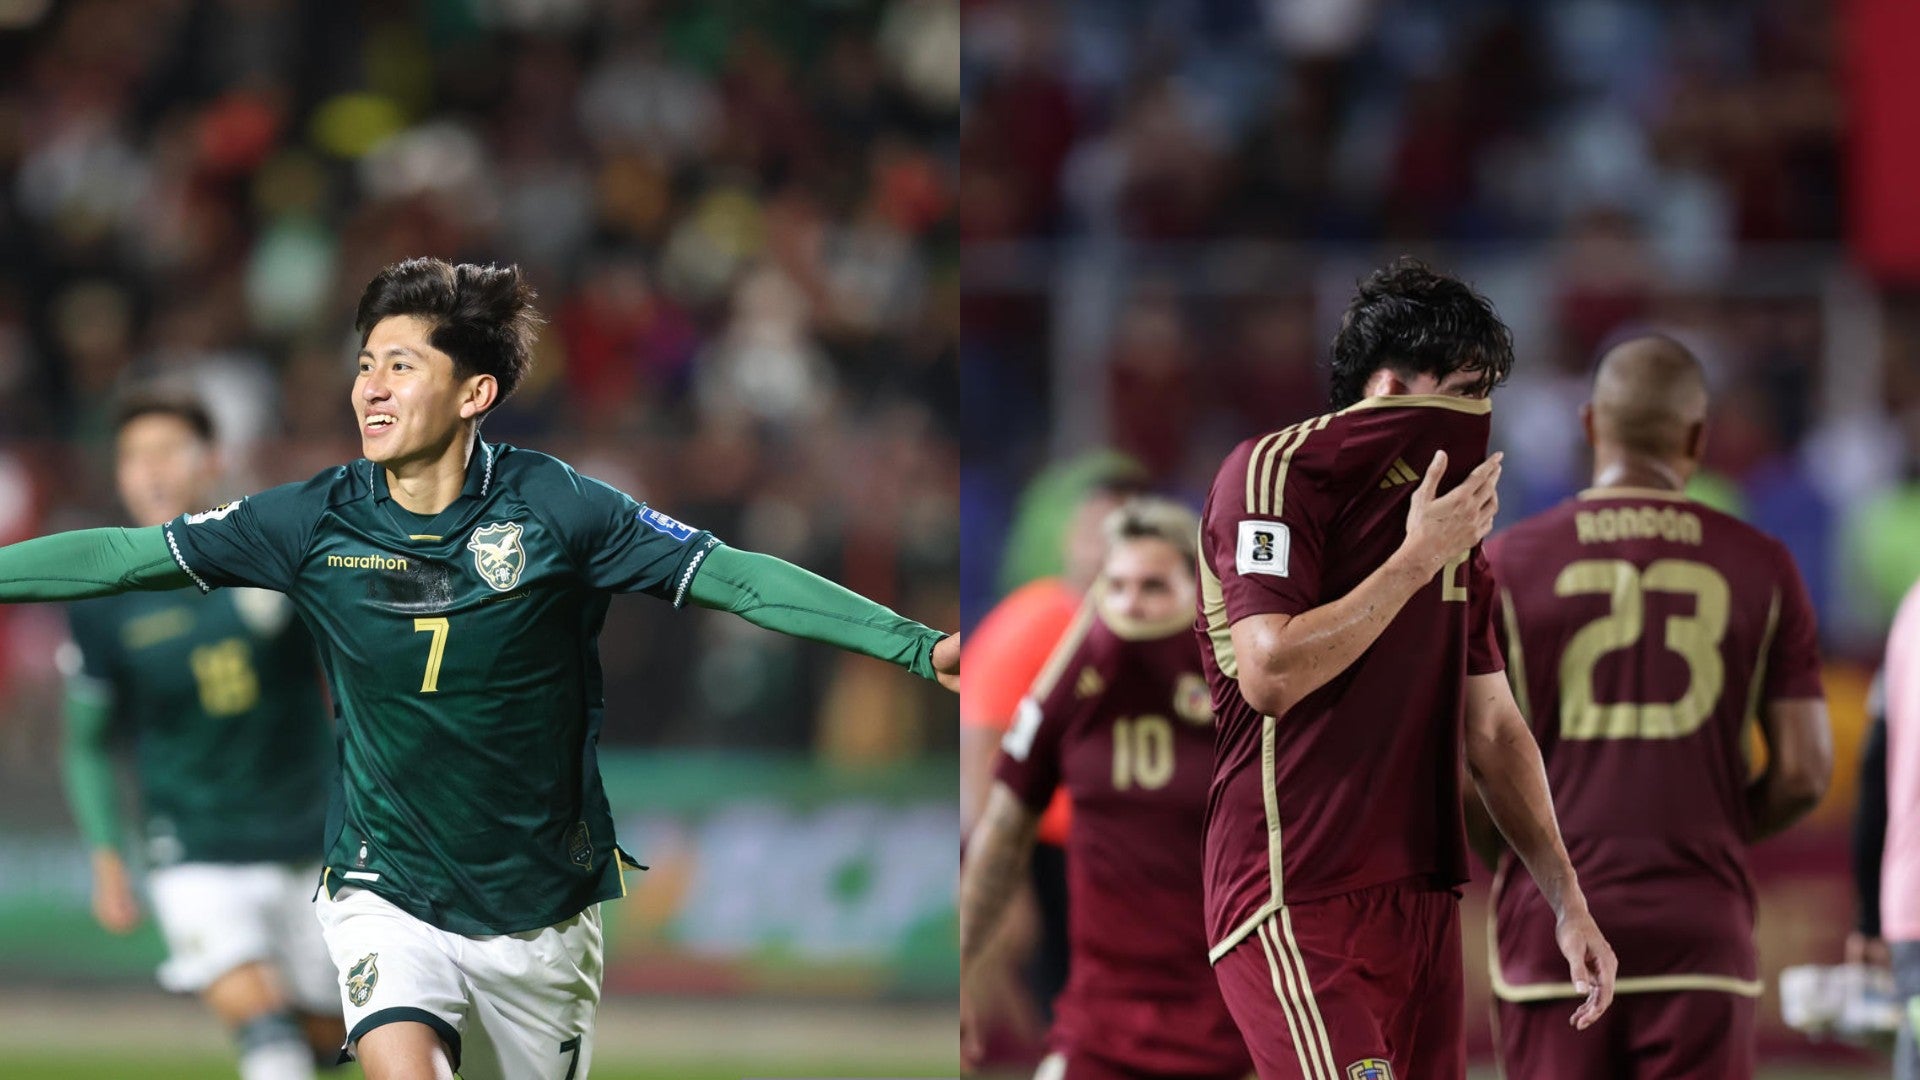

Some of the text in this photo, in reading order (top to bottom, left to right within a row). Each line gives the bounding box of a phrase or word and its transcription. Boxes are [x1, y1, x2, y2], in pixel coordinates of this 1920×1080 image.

[327, 553, 408, 571] marathon
[413, 616, 450, 693] 7
[1553, 558, 1731, 741] 23
[1111, 714, 1175, 792] 10
[559, 1033, 582, 1080] 7
